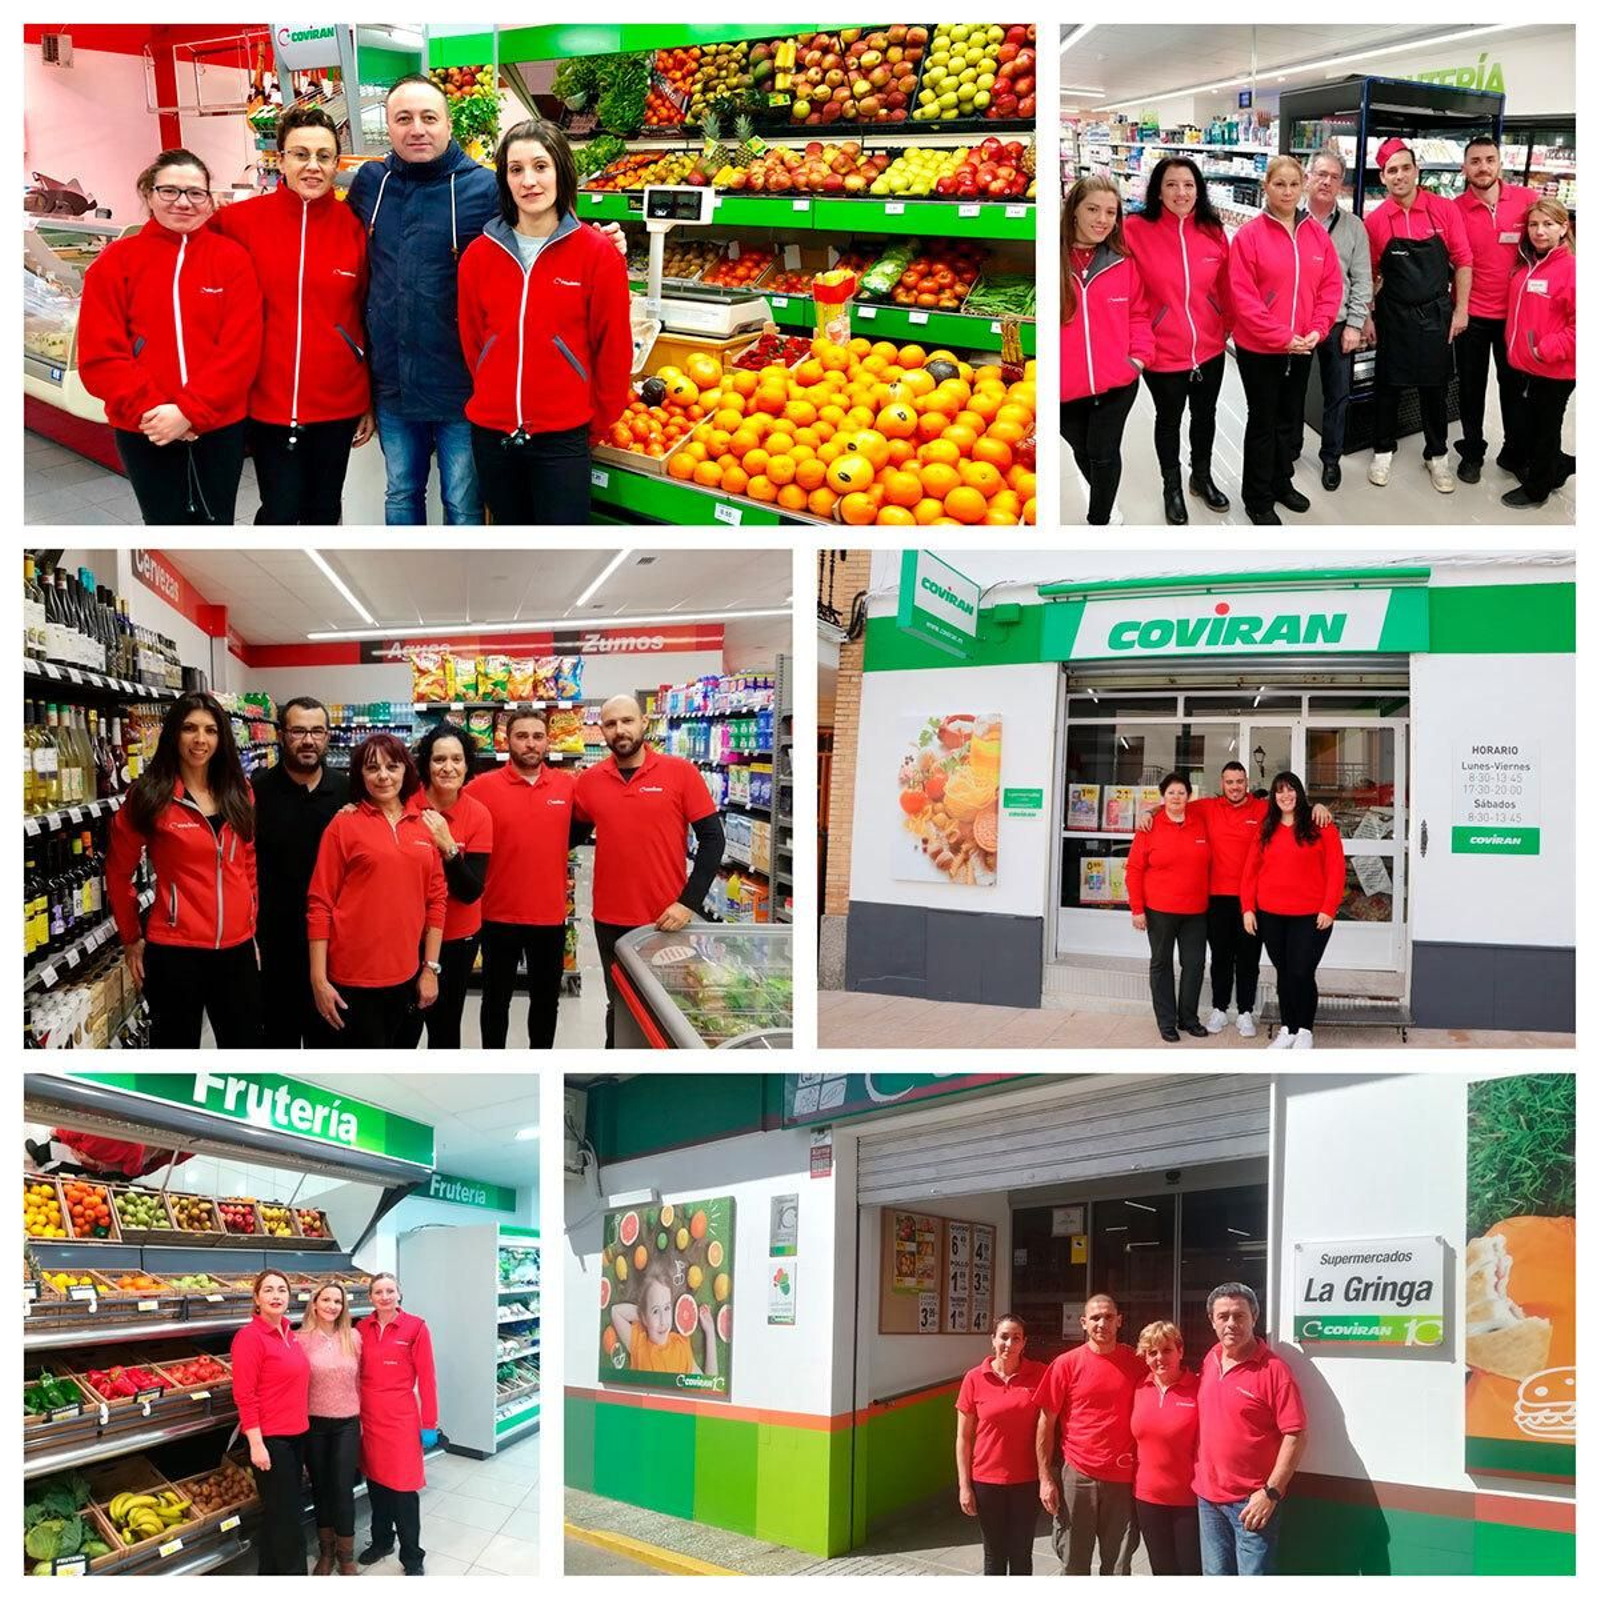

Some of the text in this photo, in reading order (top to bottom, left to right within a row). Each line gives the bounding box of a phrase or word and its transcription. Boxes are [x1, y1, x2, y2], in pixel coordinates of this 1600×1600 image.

[291, 25, 335, 42] COVIRAN
[135, 549, 179, 602] Cervezas
[921, 577, 974, 616] COVIRAN
[1107, 602, 1347, 650] COVIRAN
[582, 634, 664, 652] Zumos
[1472, 745, 1519, 755] HORARIO
[1461, 762, 1531, 771] Lunes-Viernes
[1473, 799, 1517, 809] Sábados
[1470, 834, 1522, 845] COVIRAN
[192, 1073, 359, 1143] Frutería
[1320, 1250, 1413, 1267] Supermercados
[1304, 1275, 1434, 1308] La Gringa
[1323, 1322, 1393, 1336] COVIRAN
